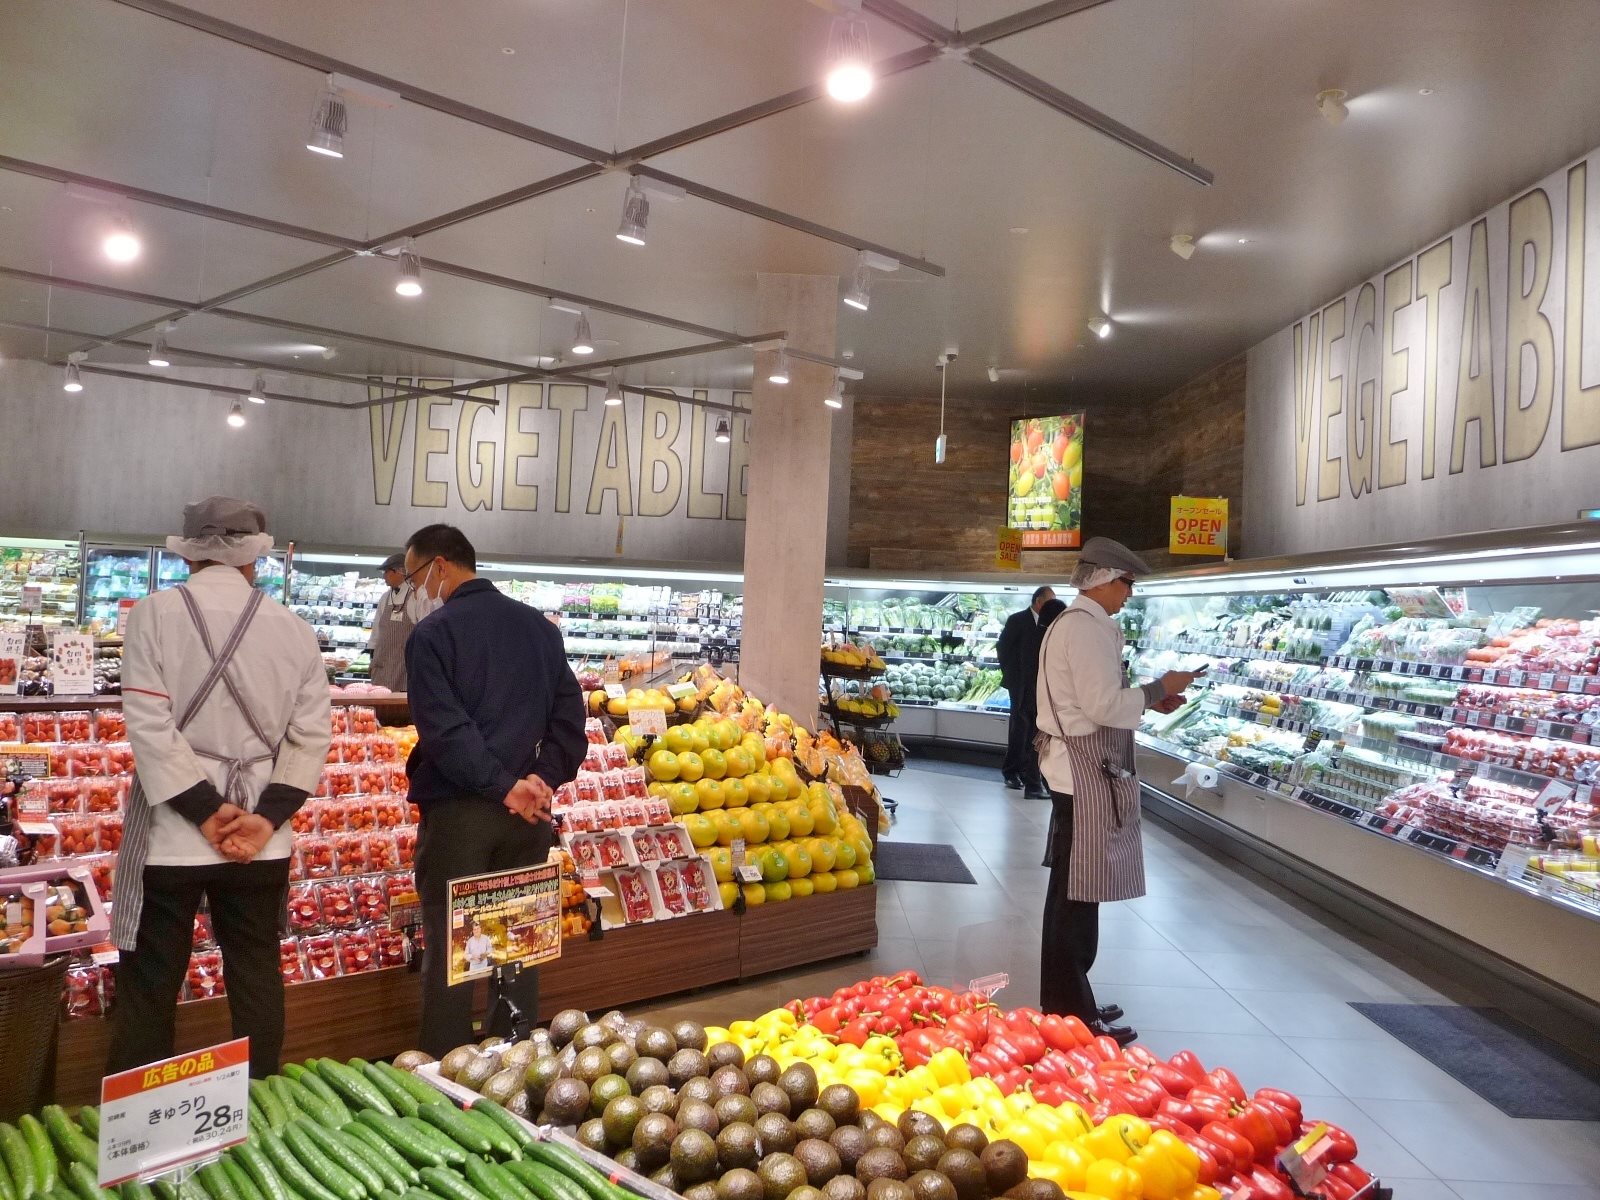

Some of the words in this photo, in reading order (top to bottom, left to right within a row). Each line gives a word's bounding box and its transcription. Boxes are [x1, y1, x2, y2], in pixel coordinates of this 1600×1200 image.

[366, 375, 751, 521] VEGETABLE
[1175, 518, 1222, 532] OPEN
[1177, 532, 1217, 545] SALE
[999, 541, 1021, 553] OPEN
[999, 551, 1018, 562] SALE
[142, 1052, 215, 1088] 広告の品
[148, 1095, 206, 1125] きゅうり
